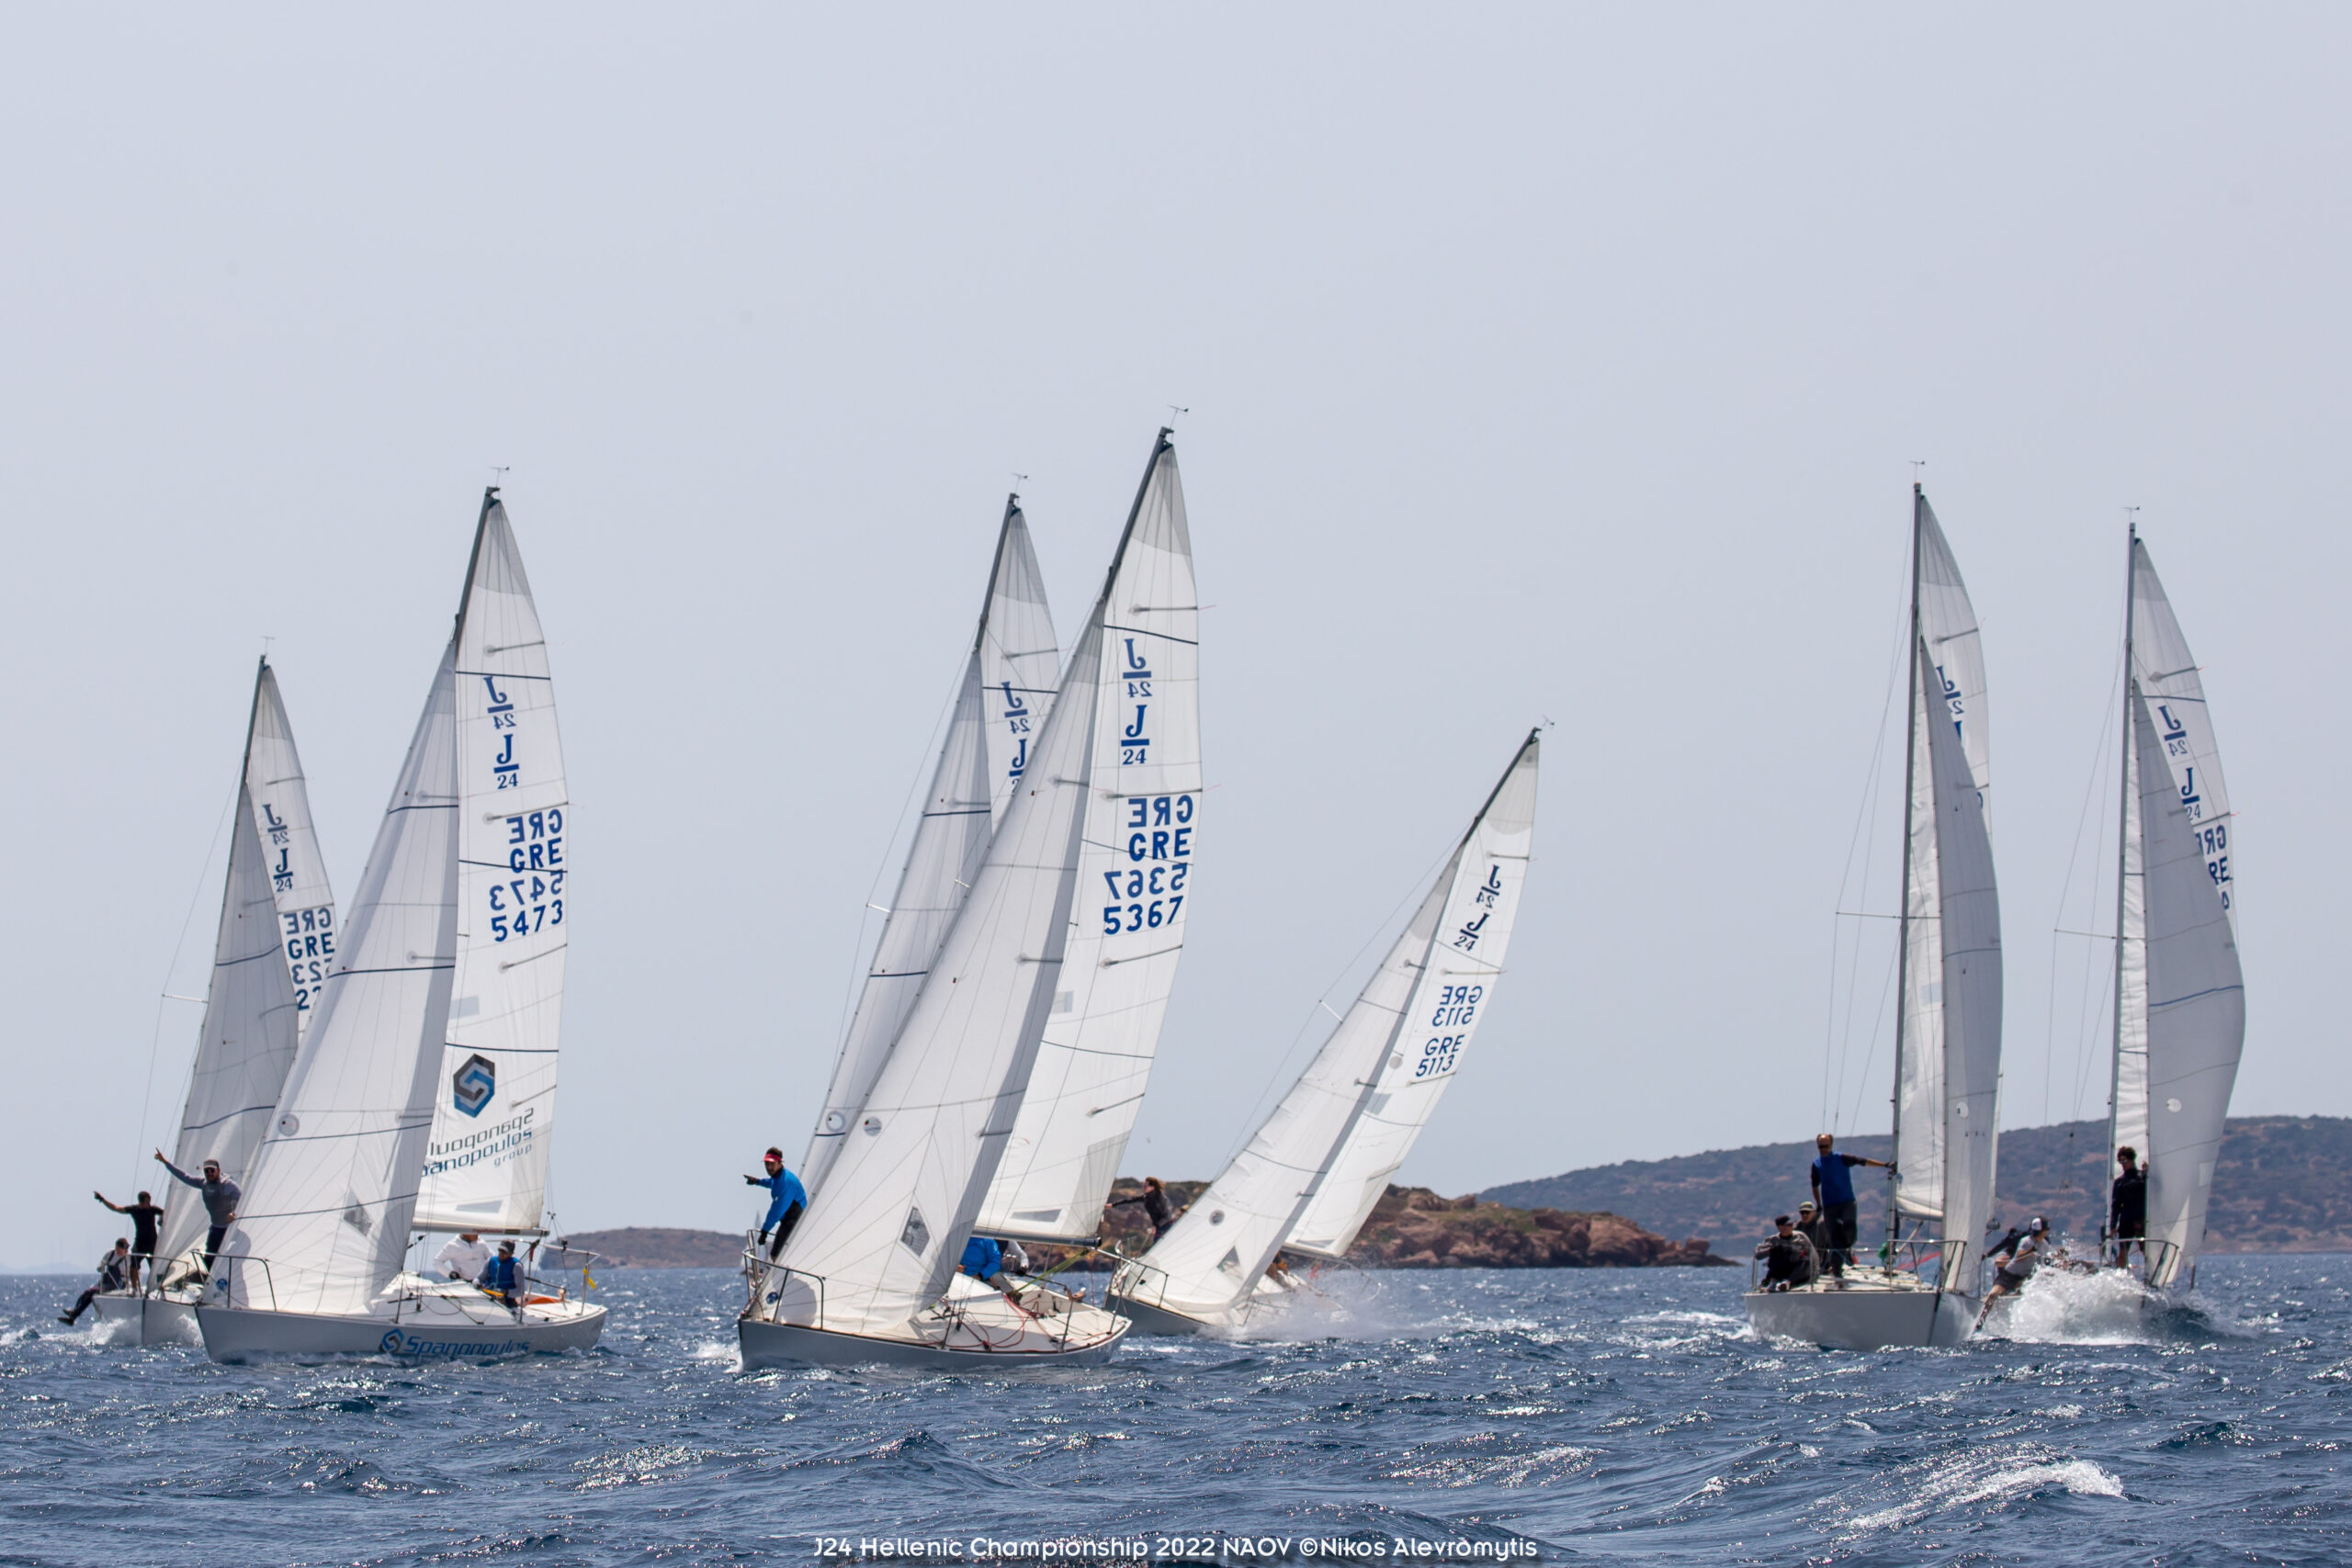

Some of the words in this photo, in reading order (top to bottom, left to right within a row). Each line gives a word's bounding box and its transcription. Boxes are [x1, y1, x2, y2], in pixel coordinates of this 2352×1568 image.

[1125, 704, 1148, 738] J
[495, 733, 514, 764] J
[1012, 738, 1027, 768] J
[1122, 748, 1147, 765] 24
[497, 773, 518, 790] 24
[2181, 767, 2193, 796] J
[510, 837, 563, 874] GRE
[1128, 827, 1193, 862] GRE
[276, 848, 288, 874] J
[2208, 856, 2230, 886] RE
[276, 877, 294, 893] 24
[491, 899, 563, 942] 5473
[1103, 896, 1183, 935] 5367
[1466, 913, 1490, 931] J
[288, 931, 335, 960] GRE
[1453, 935, 1476, 952] 24
[1425, 1034, 1465, 1055] GRE
[1416, 1054, 1455, 1077] 5113
[423, 1127, 533, 1177] anopoulos
[493, 1144, 533, 1168] group
